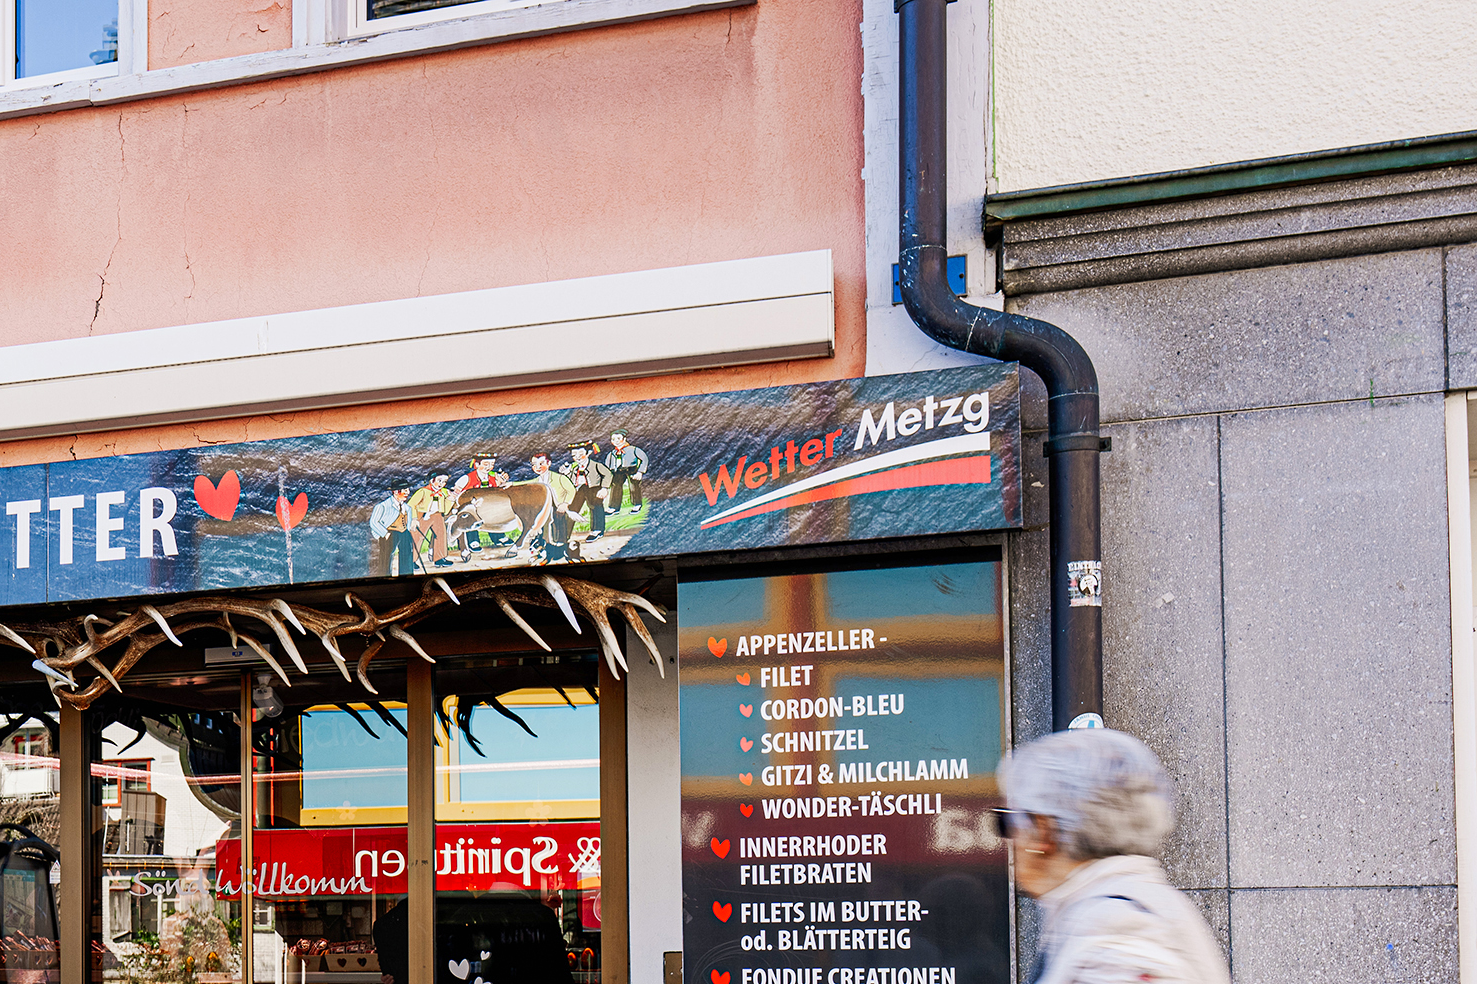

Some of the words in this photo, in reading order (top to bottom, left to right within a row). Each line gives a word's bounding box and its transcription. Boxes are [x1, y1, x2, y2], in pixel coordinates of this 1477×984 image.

[698, 428, 842, 507] Wetter
[854, 391, 990, 451] Metzg
[760, 665, 814, 688] FILET
[760, 694, 905, 721] CORDON-BLEU
[760, 729, 869, 754] SCHNITZEL
[761, 764, 812, 787] GITZI
[817, 763, 834, 785] &
[838, 758, 969, 784] MILCHLAMM
[761, 791, 942, 820] WONDER-TÄSCHLI
[739, 834, 887, 858] INNERRHODER
[129, 868, 209, 897] Sönd
[740, 862, 872, 886] FILETBRATEN
[740, 902, 805, 923] FILETS
[810, 902, 836, 922] IM
[841, 900, 929, 922] BUTTER-
[740, 929, 773, 951] od.
[778, 925, 911, 951] BLÄTTERTEIG
